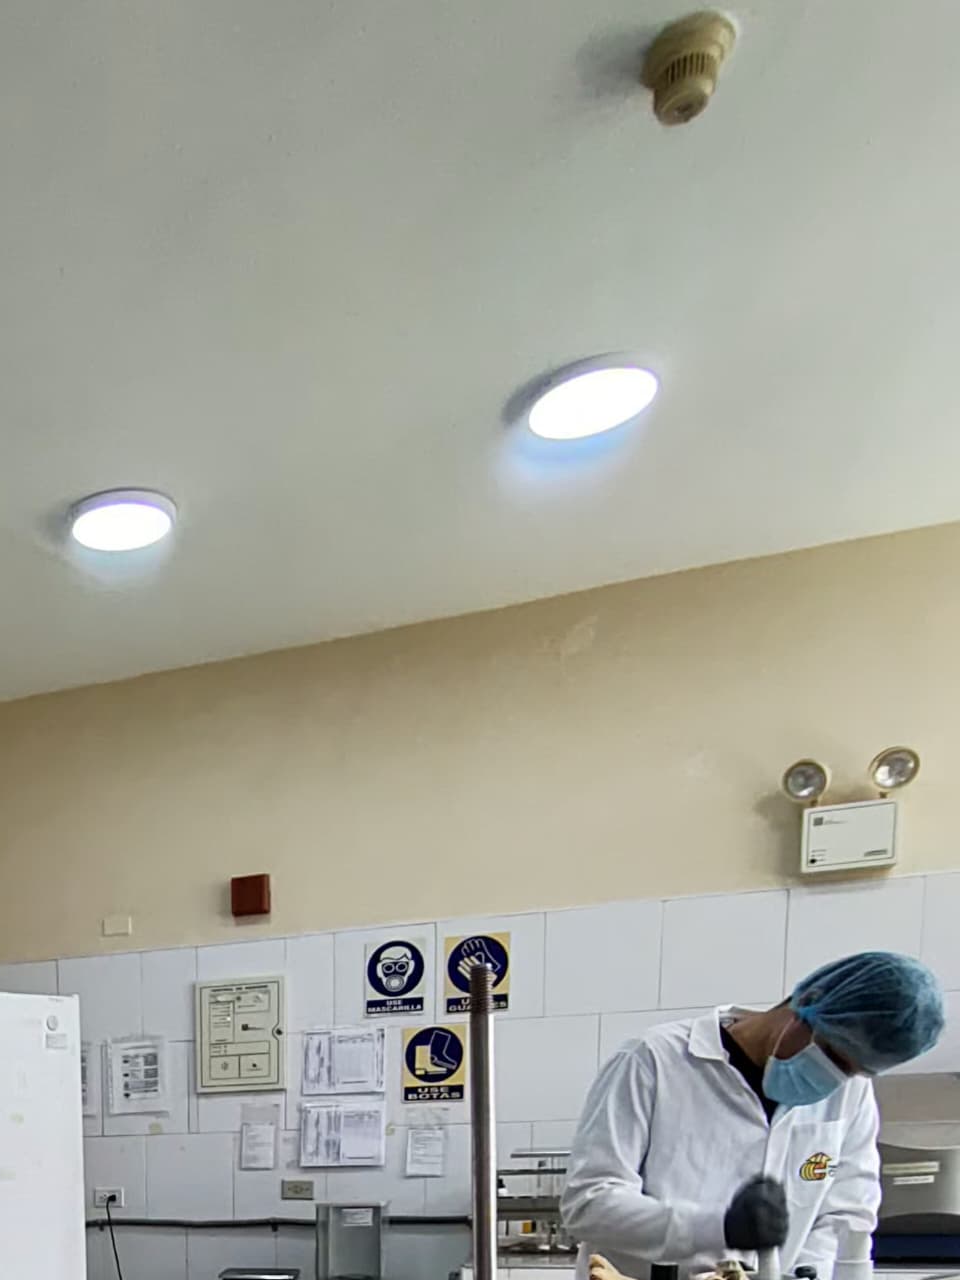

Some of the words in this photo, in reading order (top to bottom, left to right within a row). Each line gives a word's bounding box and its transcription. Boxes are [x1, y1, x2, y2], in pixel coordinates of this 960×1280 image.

[368, 1004, 422, 1013] MASCARILLA
[417, 1083, 449, 1093] USE
[408, 1092, 460, 1100] BOTAS
